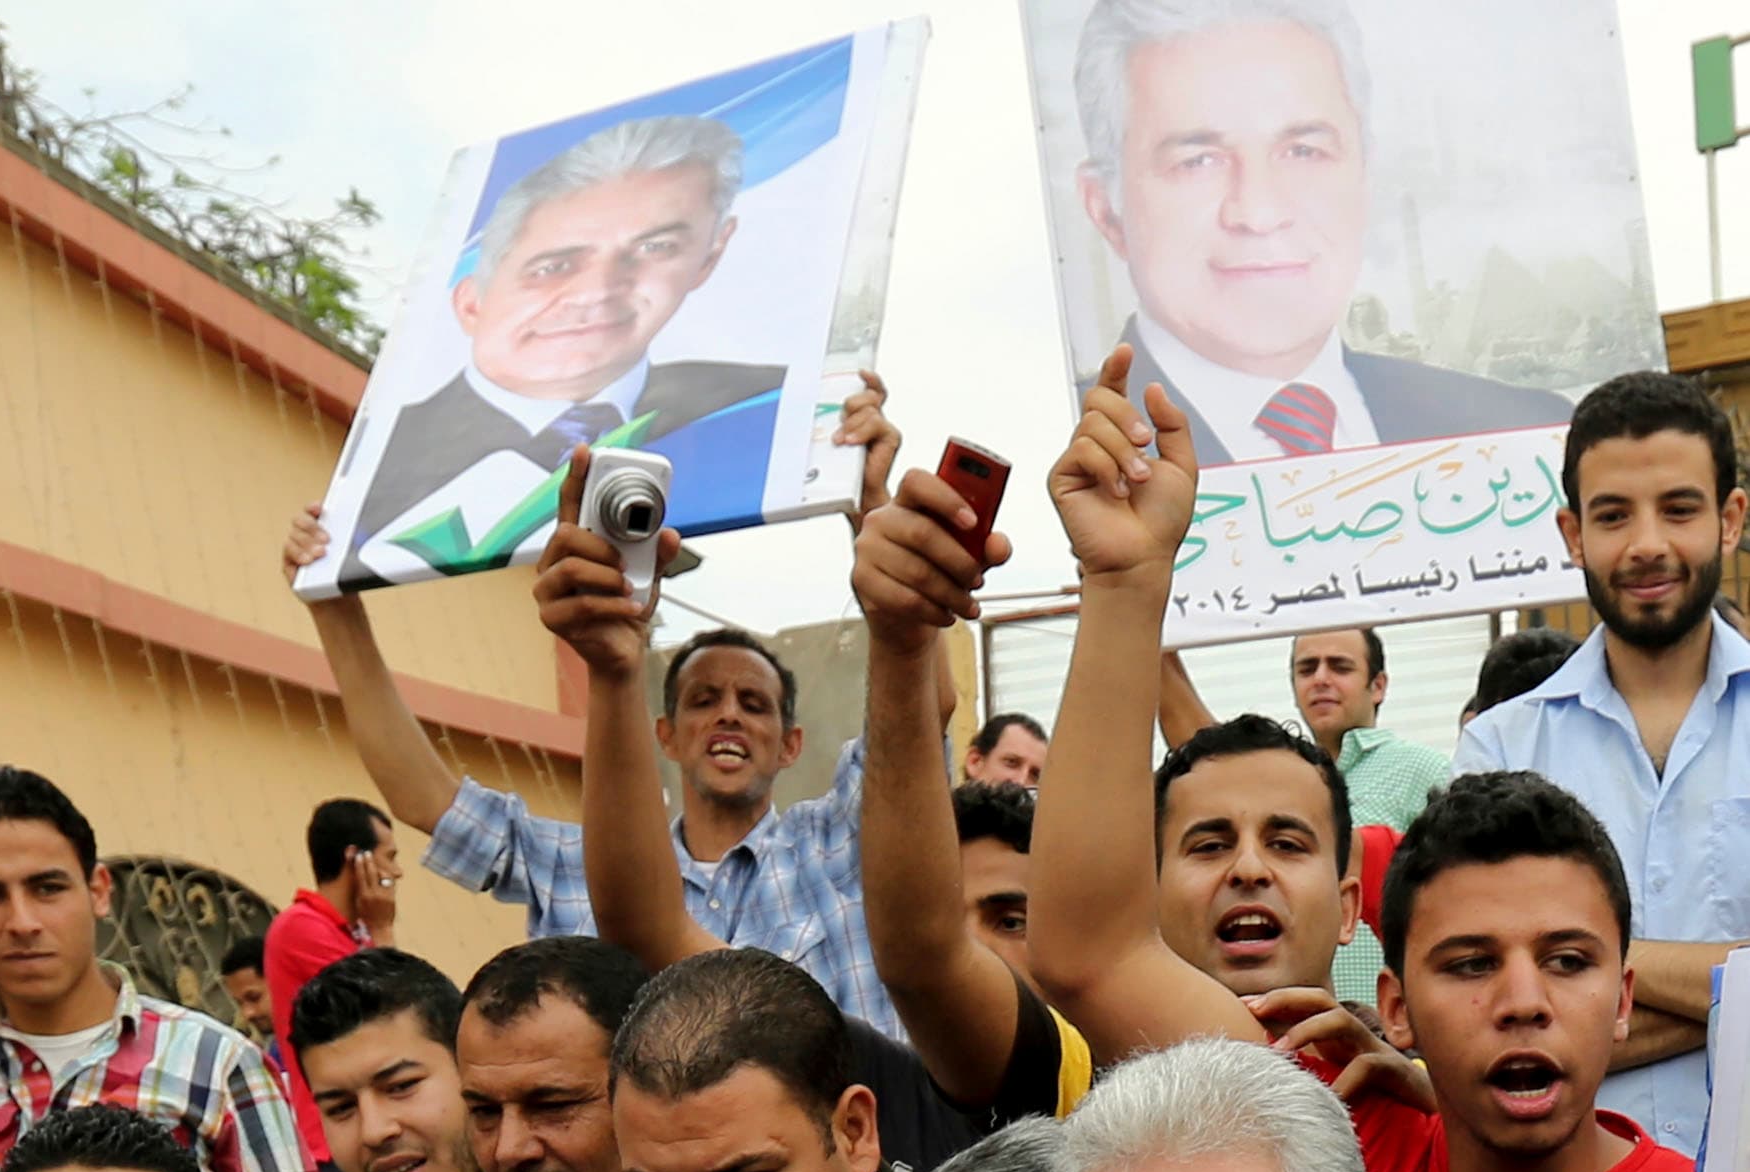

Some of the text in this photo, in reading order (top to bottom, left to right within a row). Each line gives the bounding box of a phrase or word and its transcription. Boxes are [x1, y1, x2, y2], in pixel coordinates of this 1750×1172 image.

[1413, 454, 1568, 535] دين
[1172, 584, 1251, 618] ٢٠١٤
[1262, 571, 1347, 616] لمصر
